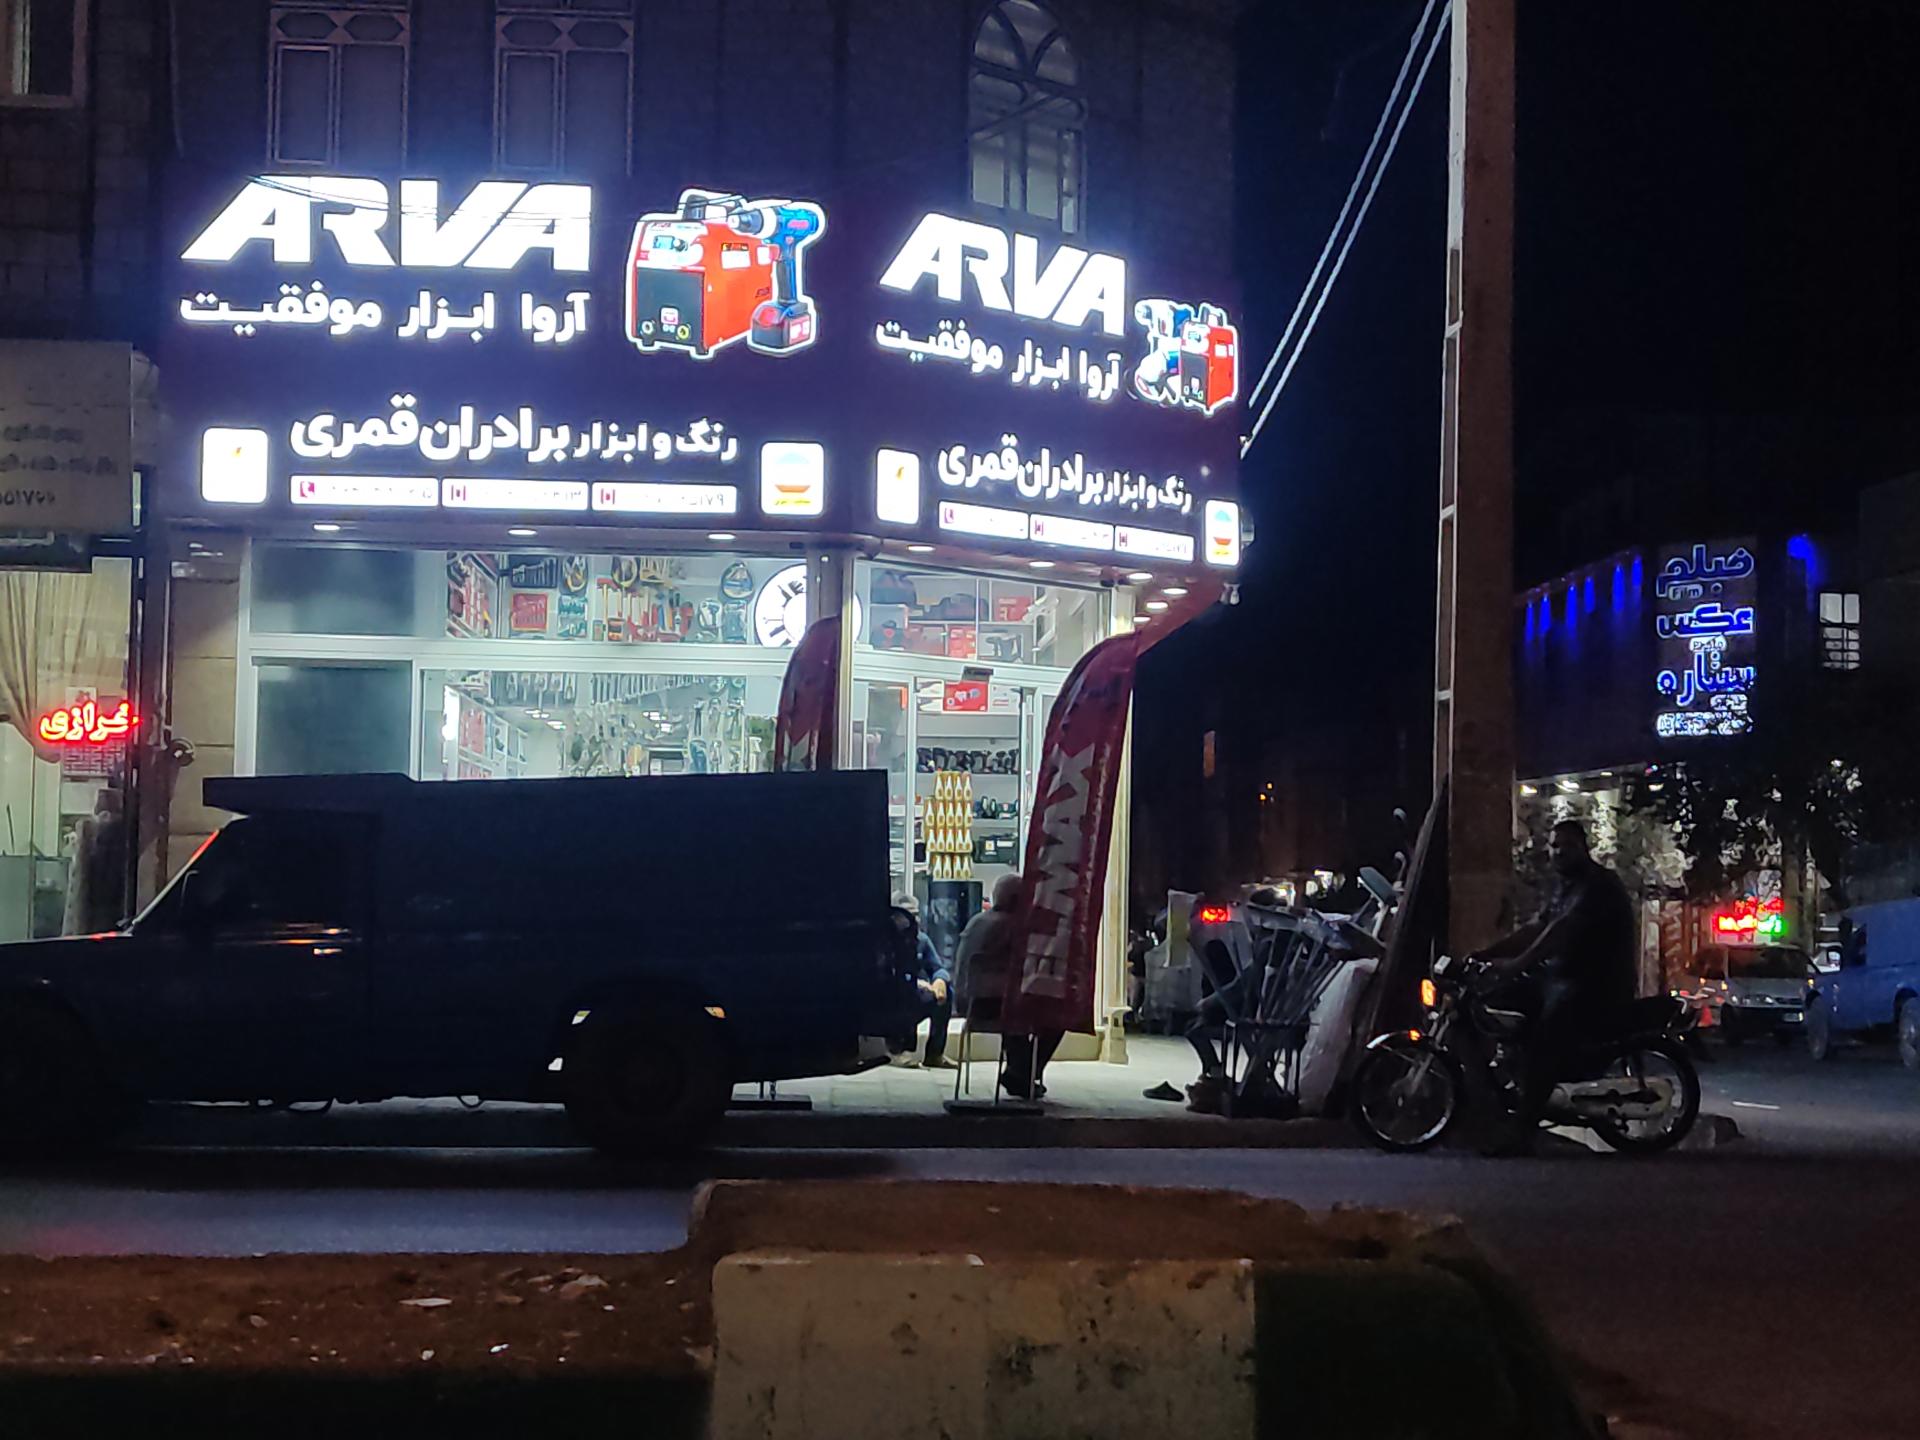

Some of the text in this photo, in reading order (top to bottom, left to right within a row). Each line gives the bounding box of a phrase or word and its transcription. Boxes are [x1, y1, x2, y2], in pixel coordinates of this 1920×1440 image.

[180, 174, 592, 271] ARVA
[880, 213, 1126, 336] ARVA
[179, 280, 591, 343] آروا ابزار موفقیت
[875, 320, 1123, 402] آروا ابزار موفقیت
[290, 393, 738, 463] رنگ و ابزار برادران قمری
[937, 433, 1193, 514] رنگ و ابزار برادران قمری
[1656, 544, 1754, 597] فیلم
[1656, 603, 1754, 639] عکس
[1656, 650, 1755, 706] ستاره
